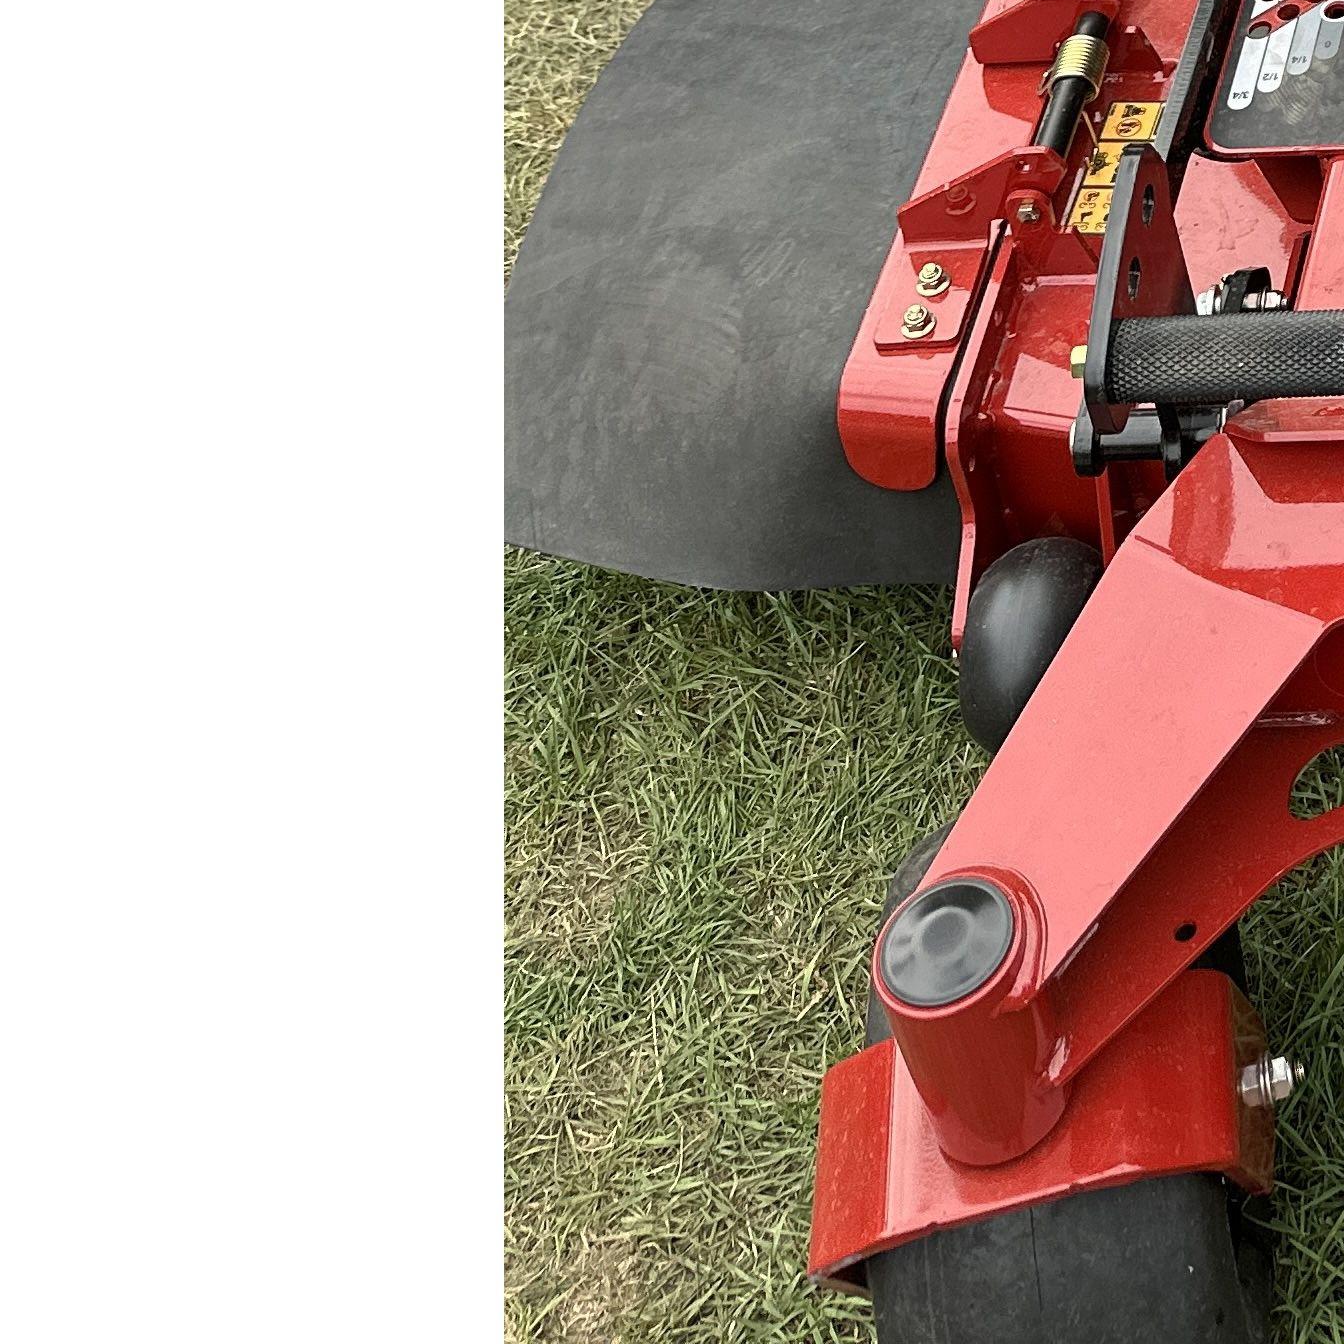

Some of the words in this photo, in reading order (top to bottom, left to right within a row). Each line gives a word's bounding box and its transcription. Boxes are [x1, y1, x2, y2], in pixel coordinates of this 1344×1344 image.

[1290, 55, 1308, 65] 1/4
[1262, 72, 1280, 81] 1/2
[1232, 90, 1250, 100] 3/4
